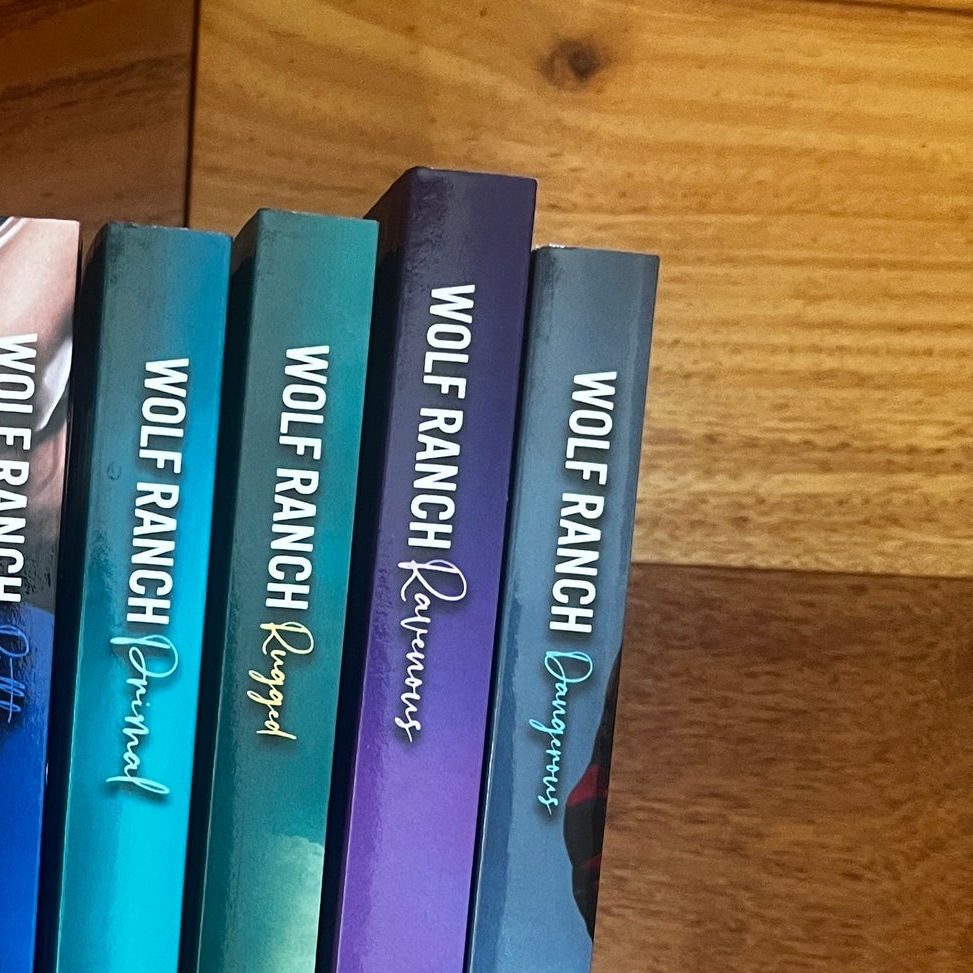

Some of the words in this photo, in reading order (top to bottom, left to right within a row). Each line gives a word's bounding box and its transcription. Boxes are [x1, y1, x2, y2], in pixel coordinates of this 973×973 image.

[279, 345, 330, 463] WOLF
[423, 284, 476, 401] WOLF
[137, 358, 189, 474] WOLF
[407, 407, 463, 551] RANCH
[565, 371, 618, 485] WOLF
[126, 482, 179, 625] RANCH
[265, 469, 320, 611] RANCH
[549, 492, 605, 634] RANCH
[106, 634, 179, 798] Primal
[247, 621, 314, 742] Rugged
[394, 559, 467, 743] Ravenous
[529, 649, 594, 816] Dangerous
